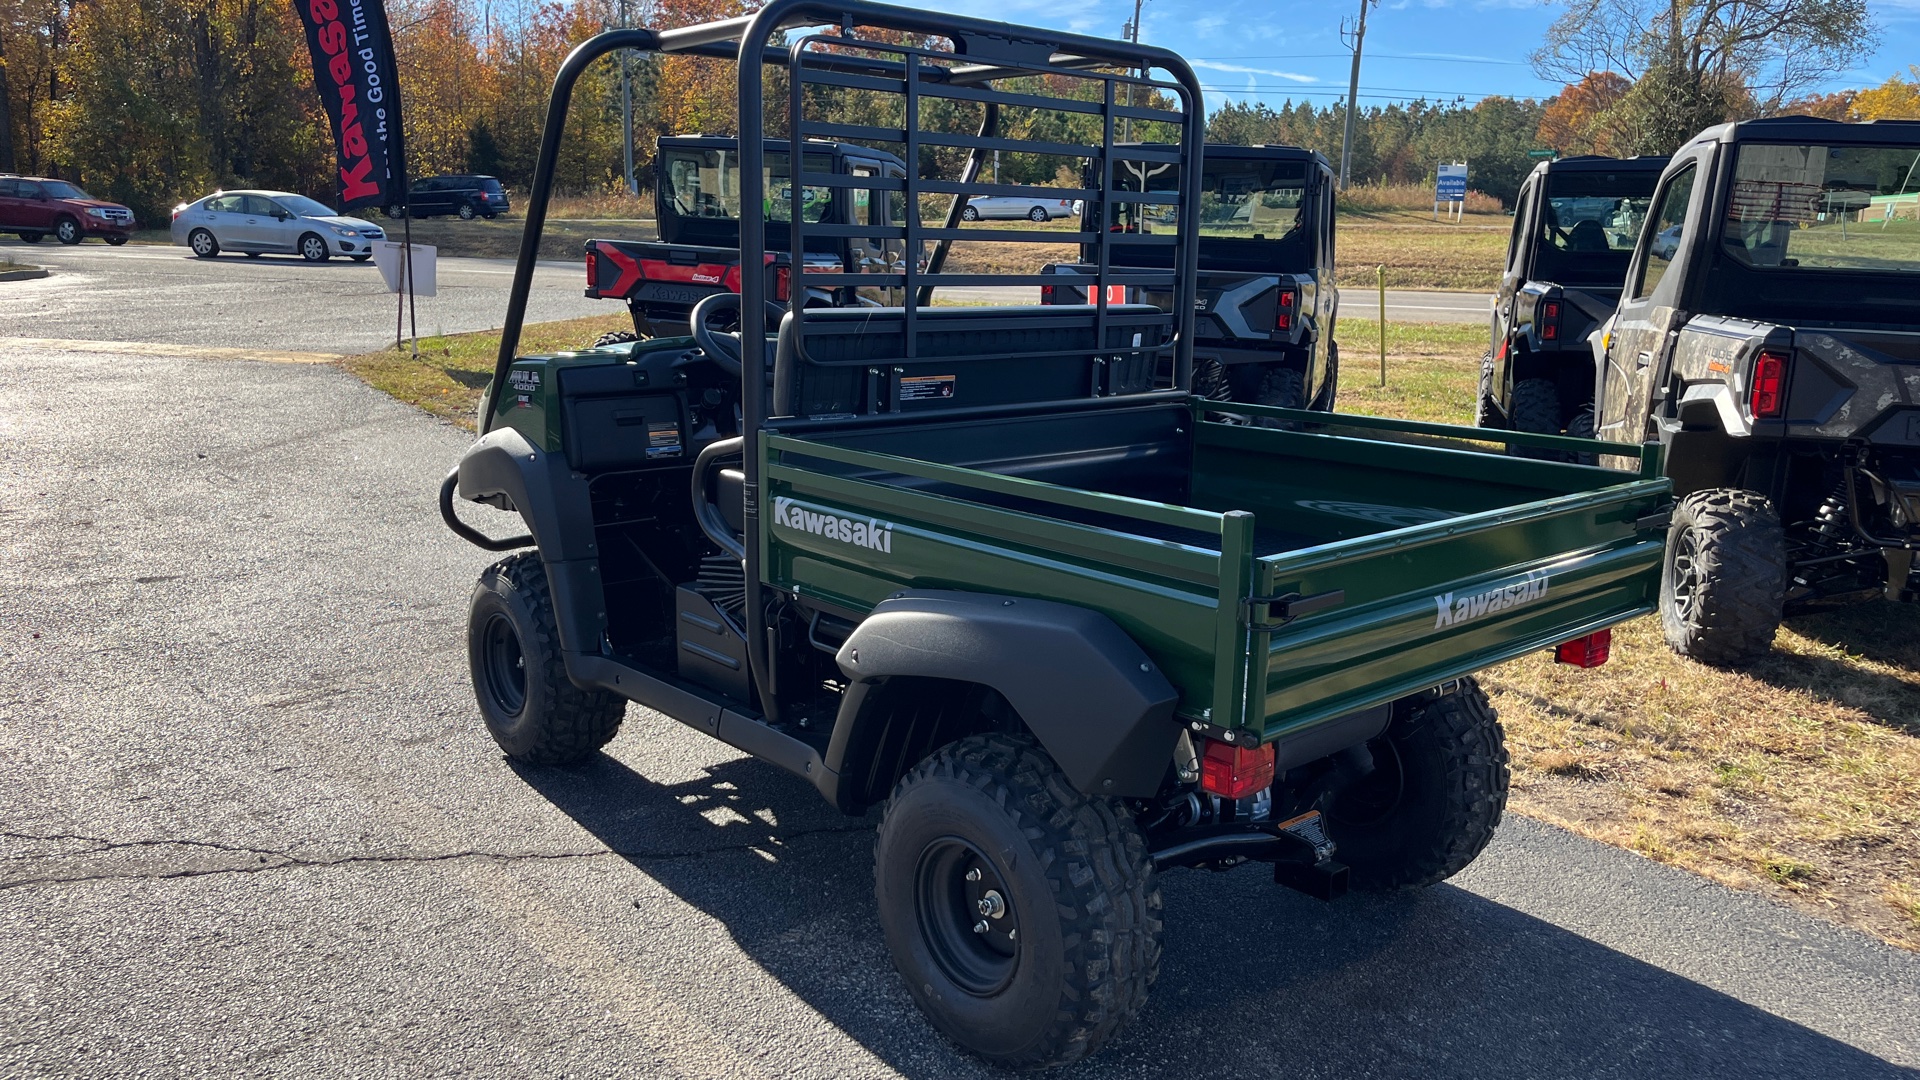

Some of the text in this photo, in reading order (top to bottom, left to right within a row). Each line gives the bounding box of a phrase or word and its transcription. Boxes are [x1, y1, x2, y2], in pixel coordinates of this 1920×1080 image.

[358, 47, 383, 103] Good
[774, 496, 894, 554] Kawasaki
[1434, 569, 1548, 630] Kawasaki
